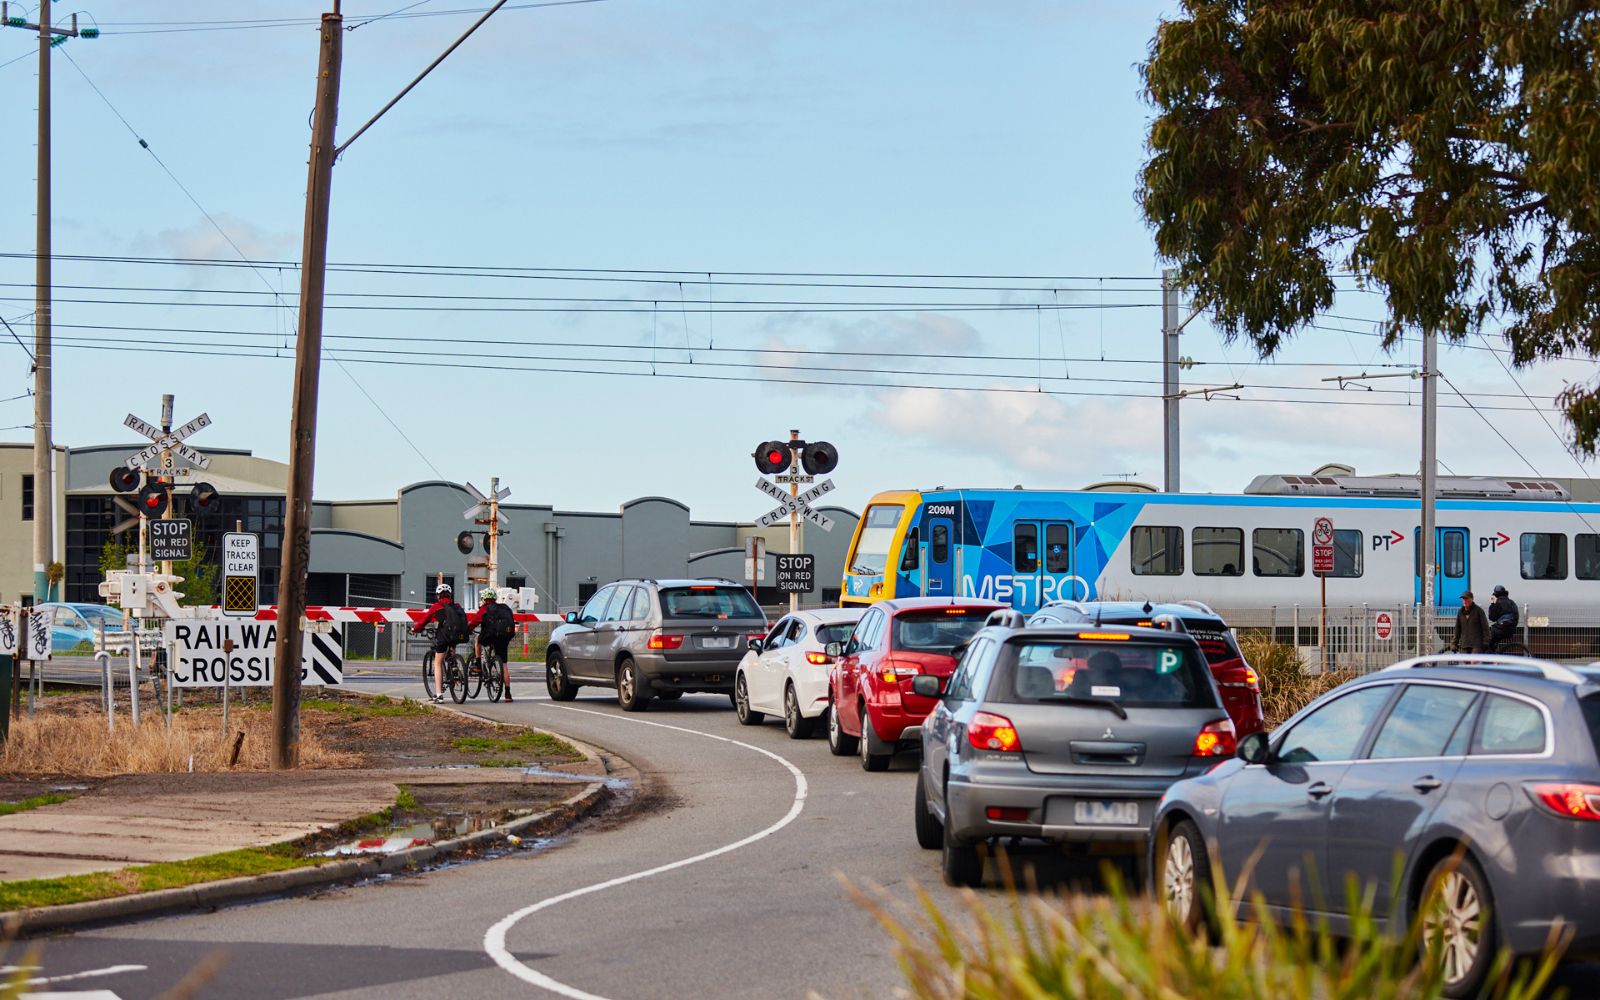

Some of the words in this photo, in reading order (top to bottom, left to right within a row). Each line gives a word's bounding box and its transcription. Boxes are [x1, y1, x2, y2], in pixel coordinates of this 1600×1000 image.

[130, 417, 206, 467] CROSSING
[165, 458, 172, 468] 3
[150, 468, 189, 476] TRACKS
[792, 466, 798, 474] 3
[778, 475, 814, 483] TRACKS
[761, 482, 829, 526] CROSSING
[928, 505, 955, 515] 209M
[153, 522, 188, 535] STOP
[153, 538, 166, 547] ON
[170, 538, 188, 547] RED
[231, 539, 250, 548] KEEP
[155, 548, 187, 557] SIGNAL
[226, 550, 256, 560] TRACKS
[228, 562, 254, 572] CLEAR
[780, 557, 812, 569] STOP
[780, 571, 791, 580] ON
[795, 571, 811, 580] RED
[780, 581, 810, 590] SIGNAL
[963, 574, 1090, 608] METRO
[175, 624, 277, 650] RAILWA
[1161, 652, 1178, 672] P
[174, 656, 308, 683] CROSSI
